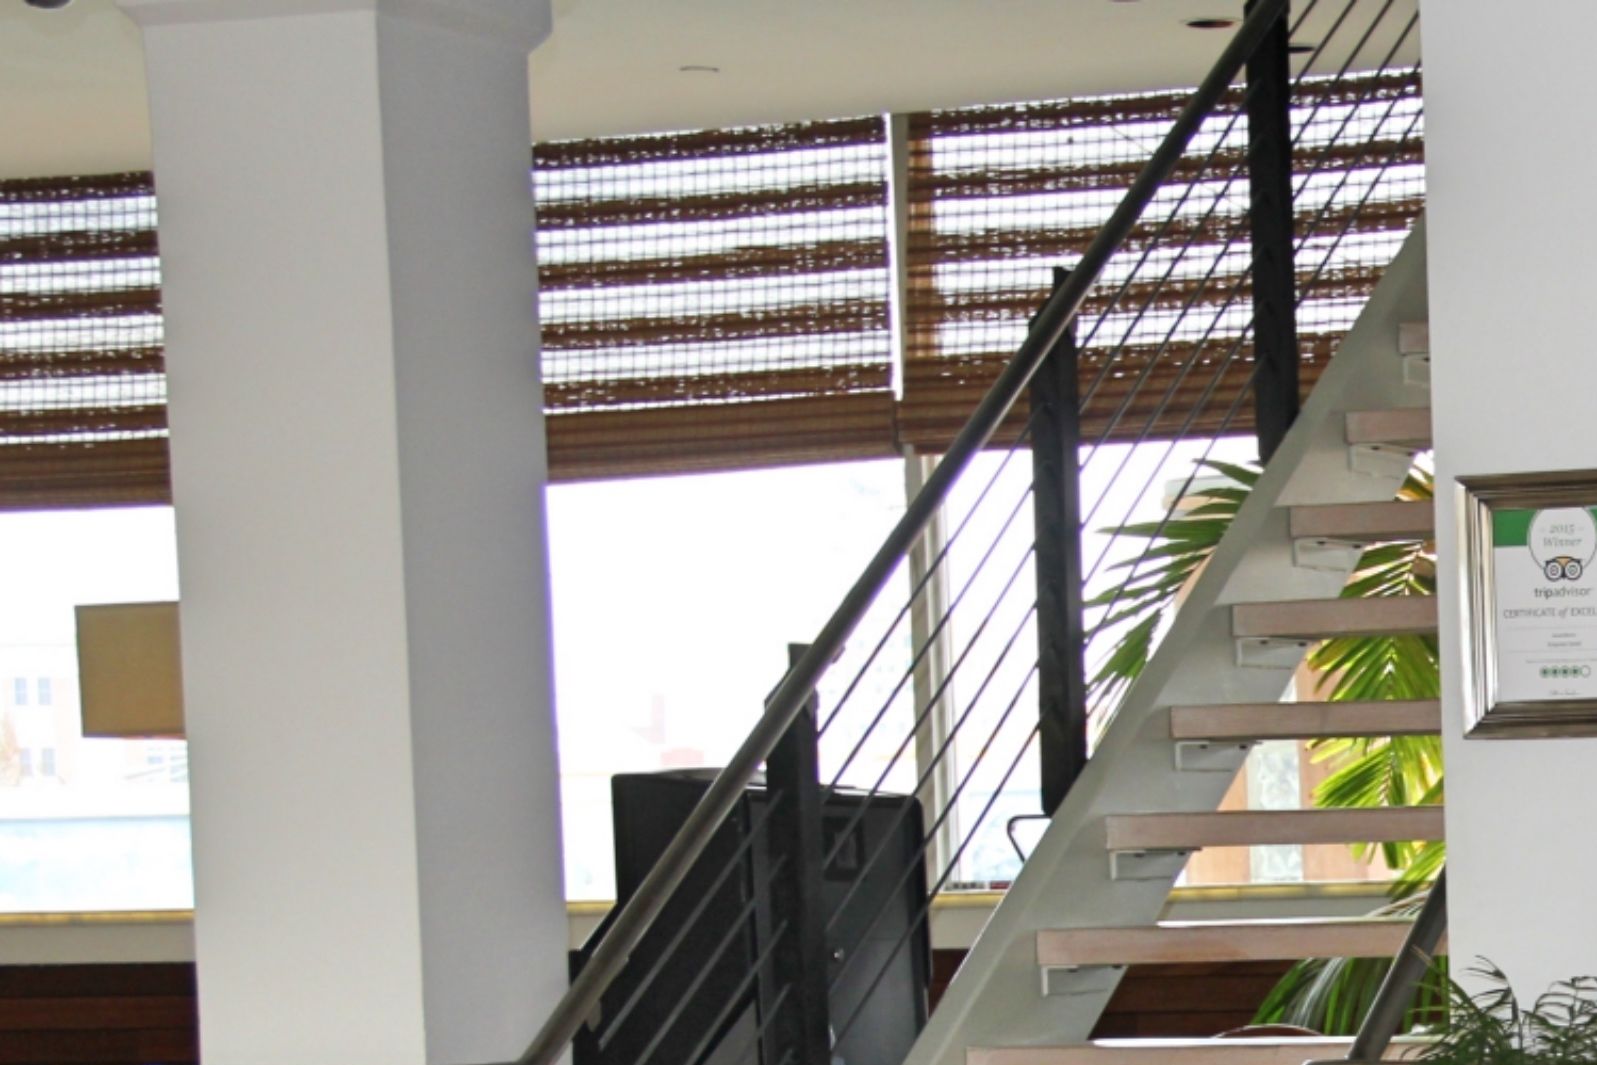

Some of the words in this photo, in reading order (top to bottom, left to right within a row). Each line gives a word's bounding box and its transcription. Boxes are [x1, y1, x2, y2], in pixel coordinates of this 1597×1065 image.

[1543, 536, 1583, 548] Winner
[1533, 586, 1592, 600] tripadvisor
[1503, 608, 1555, 619] CERTIFICATE
[1558, 607, 1568, 619] of
